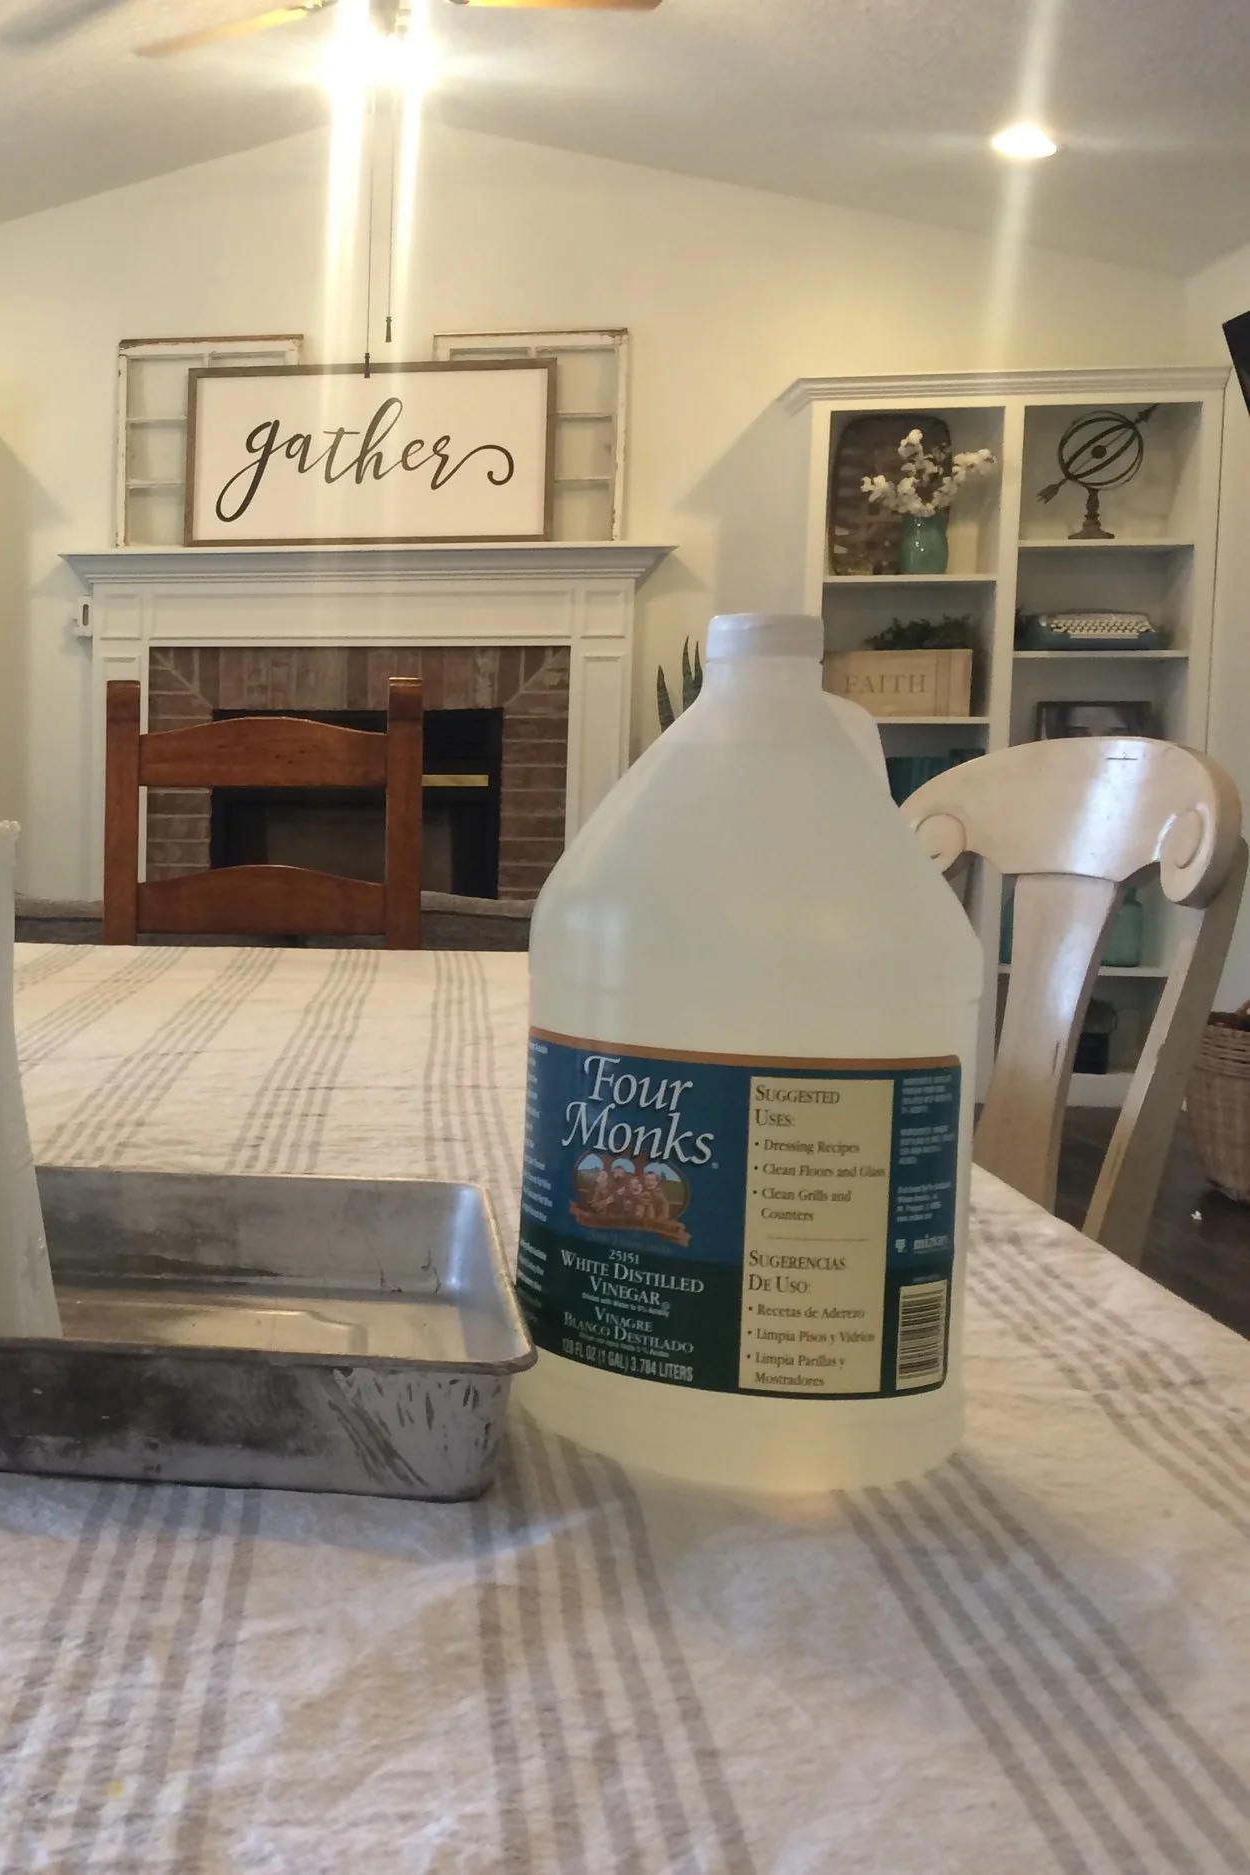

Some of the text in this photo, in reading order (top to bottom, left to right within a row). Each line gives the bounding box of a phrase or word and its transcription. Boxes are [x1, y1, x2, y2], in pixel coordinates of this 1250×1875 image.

[216, 397, 515, 523] gather
[843, 673, 927, 694] FAITH
[583, 1055, 693, 1111] Four
[561, 1101, 715, 1165] Monks
[764, 1139, 860, 1156] Dressing Recipes
[762, 1163, 886, 1178] Clean Floors and Glass
[761, 1187, 852, 1202] Clean Grills and
[761, 1208, 814, 1221] Counters
[608, 1249, 639, 1264] 25151
[757, 1303, 801, 1318] Recetas
[804, 1306, 819, 1318] de
[756, 1328, 795, 1344] Limpia
[798, 1330, 827, 1343] Pisos
[755, 1352, 794, 1368] Limpia
[659, 1362, 693, 1382] LITERS
[755, 1372, 825, 1386] Mostradores
